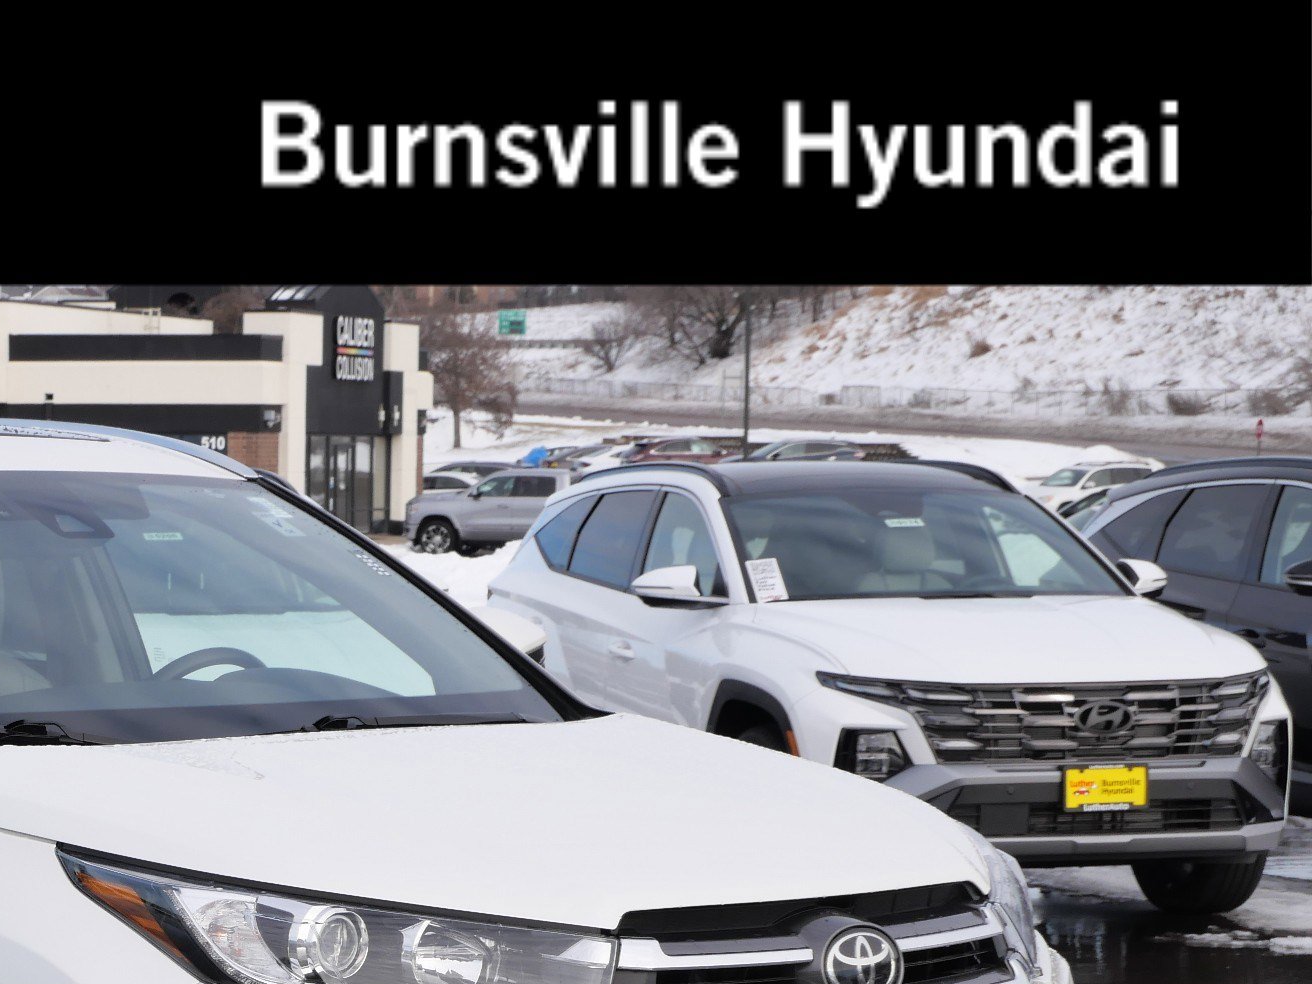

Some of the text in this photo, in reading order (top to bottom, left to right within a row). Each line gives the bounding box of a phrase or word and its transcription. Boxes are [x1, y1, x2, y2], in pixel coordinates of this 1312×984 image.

[336, 315, 375, 347] CALIBER
[336, 355, 375, 381] COLLISION
[201, 436, 225, 450] 510
